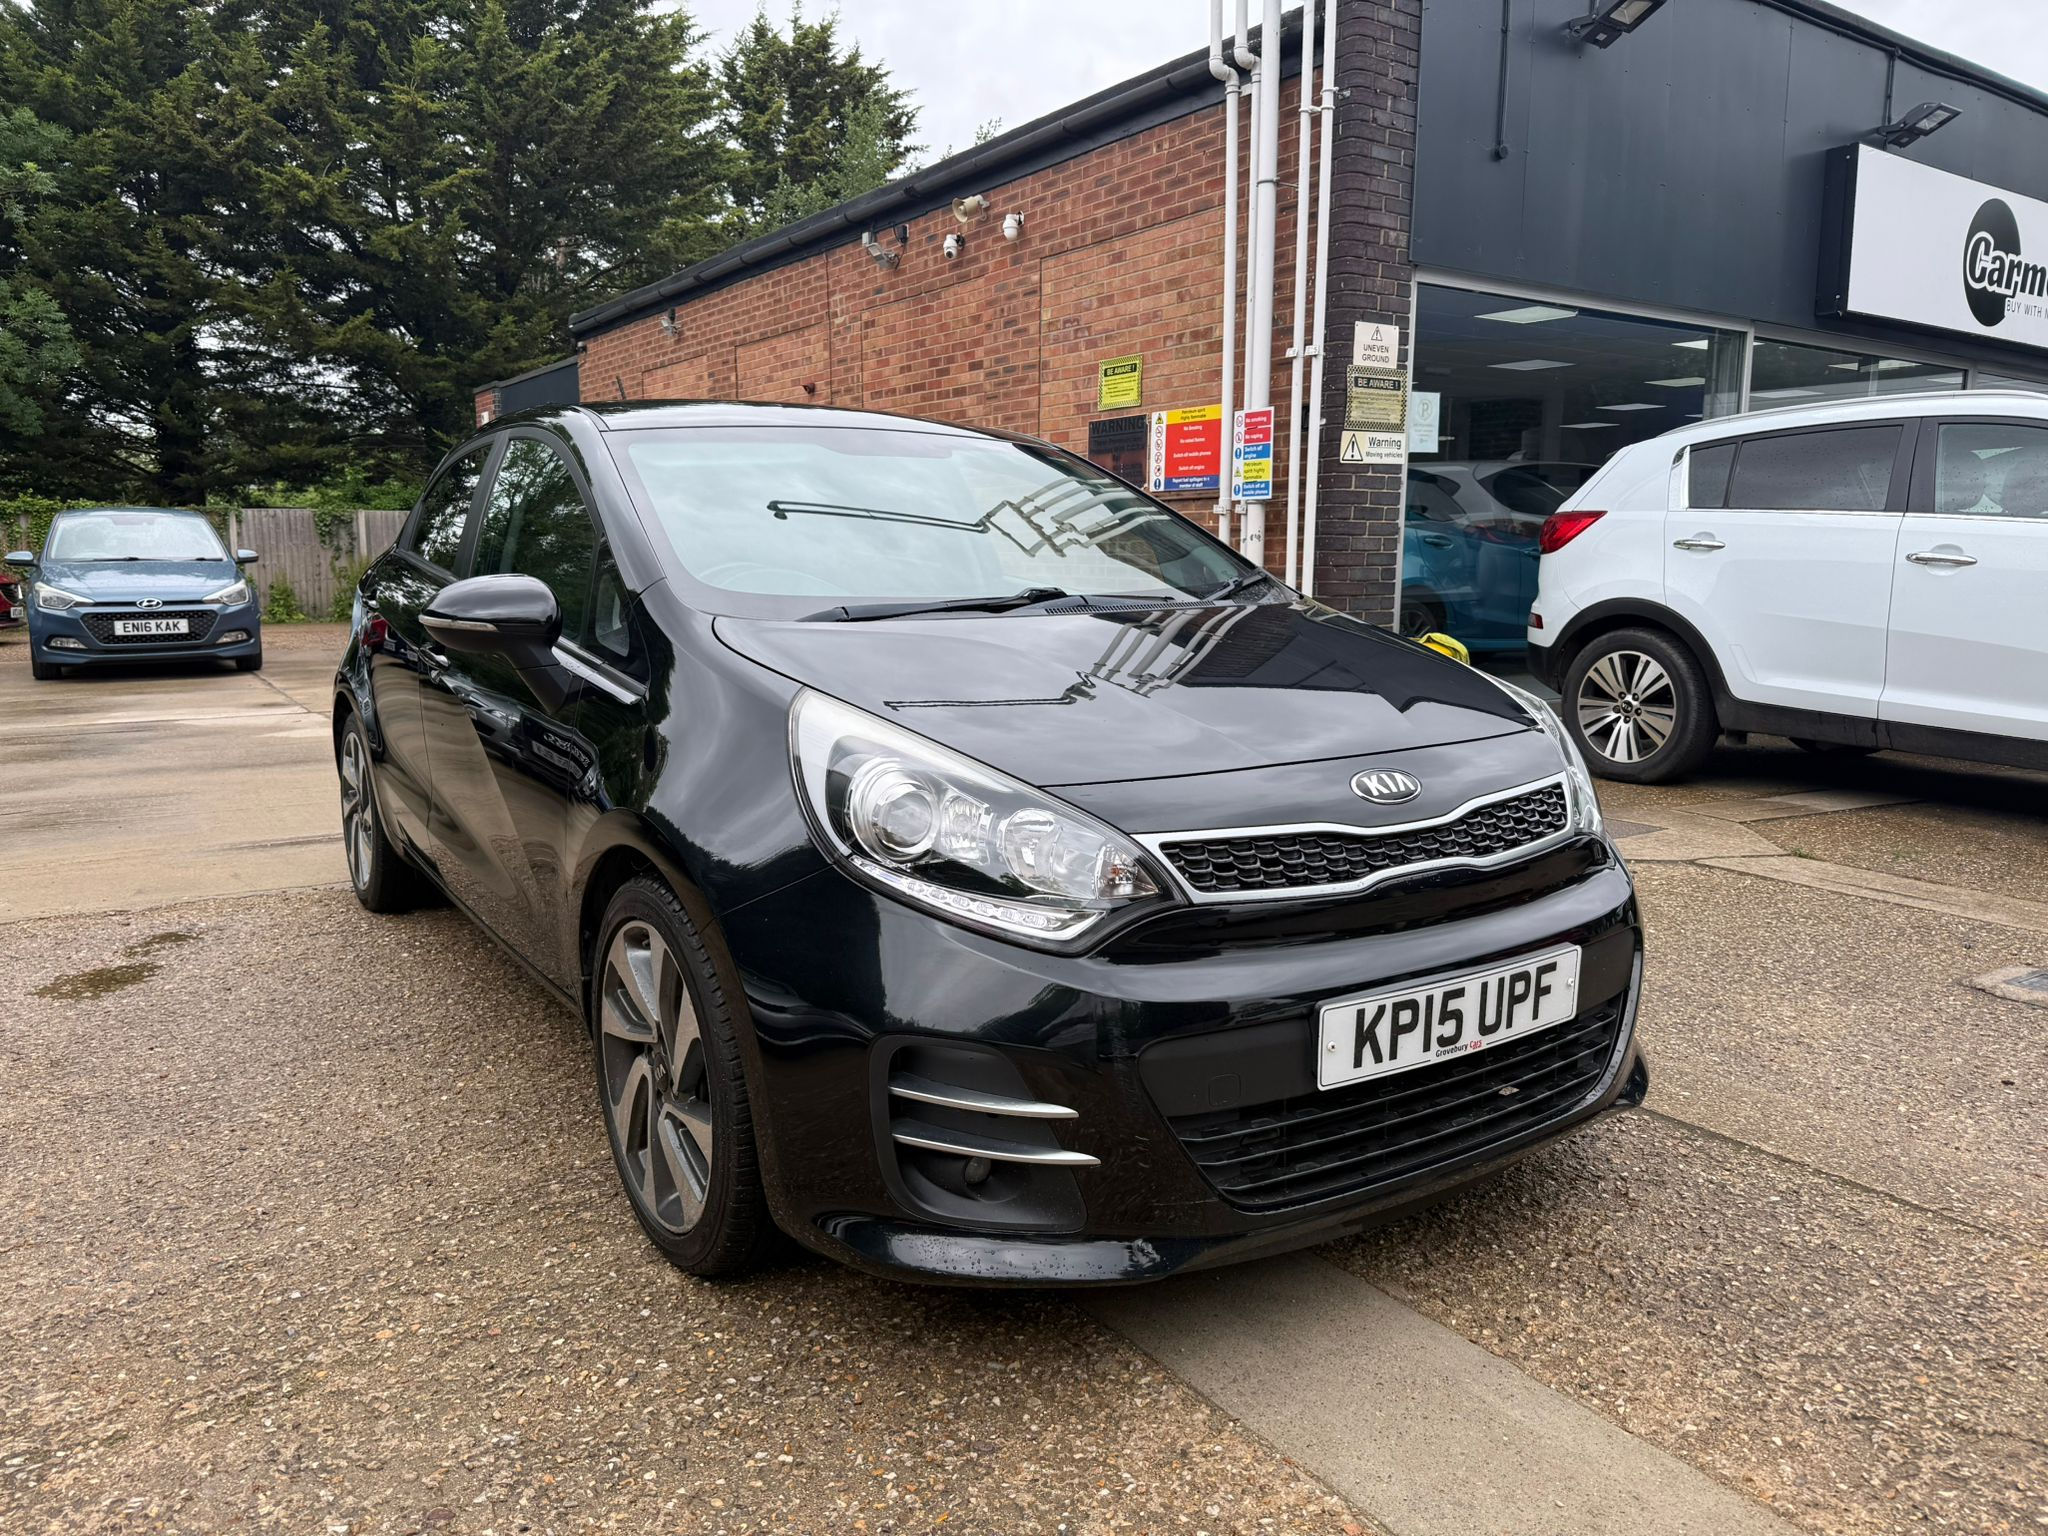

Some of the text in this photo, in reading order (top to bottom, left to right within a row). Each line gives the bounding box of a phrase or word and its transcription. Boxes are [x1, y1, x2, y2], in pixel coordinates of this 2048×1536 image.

[1968, 236, 2048, 298] Carm
[2006, 299, 2021, 314] BUY
[2024, 303, 2043, 318] WITH
[1363, 344, 1390, 353] UNEVEN
[1361, 354, 1390, 363] GROUND
[1106, 368, 1114, 376] BE
[1114, 365, 1132, 374] AWARE
[1357, 378, 1368, 387] BE
[1368, 379, 1394, 389] AWARE
[1091, 416, 1145, 435] WARNING
[1368, 436, 1402, 450] Warning
[1366, 451, 1383, 459] Moving
[123, 620, 181, 633] EN16 KAK
[1360, 772, 1416, 797] KIA
[1353, 961, 1558, 1069] KP15 UPF
[1435, 1040, 1482, 1058] Grovebury Cars
